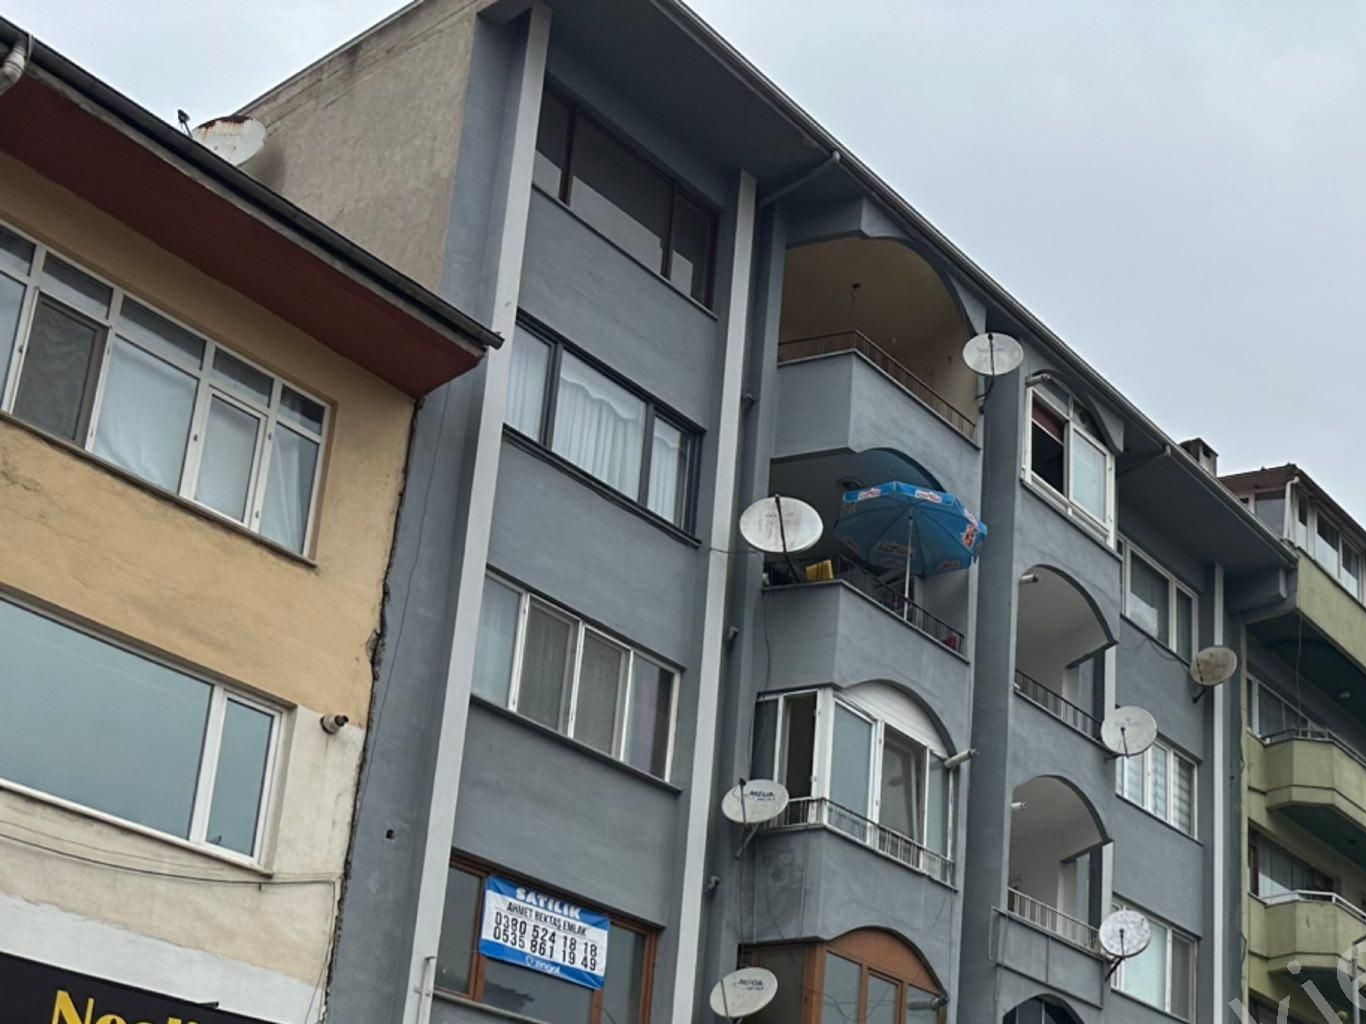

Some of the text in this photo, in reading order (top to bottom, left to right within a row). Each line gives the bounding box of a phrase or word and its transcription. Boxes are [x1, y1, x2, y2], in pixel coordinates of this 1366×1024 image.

[516, 888, 581, 919] SATILIK
[495, 912, 597, 958] 0380 524 18 18
[581, 956, 597, 971] 49
